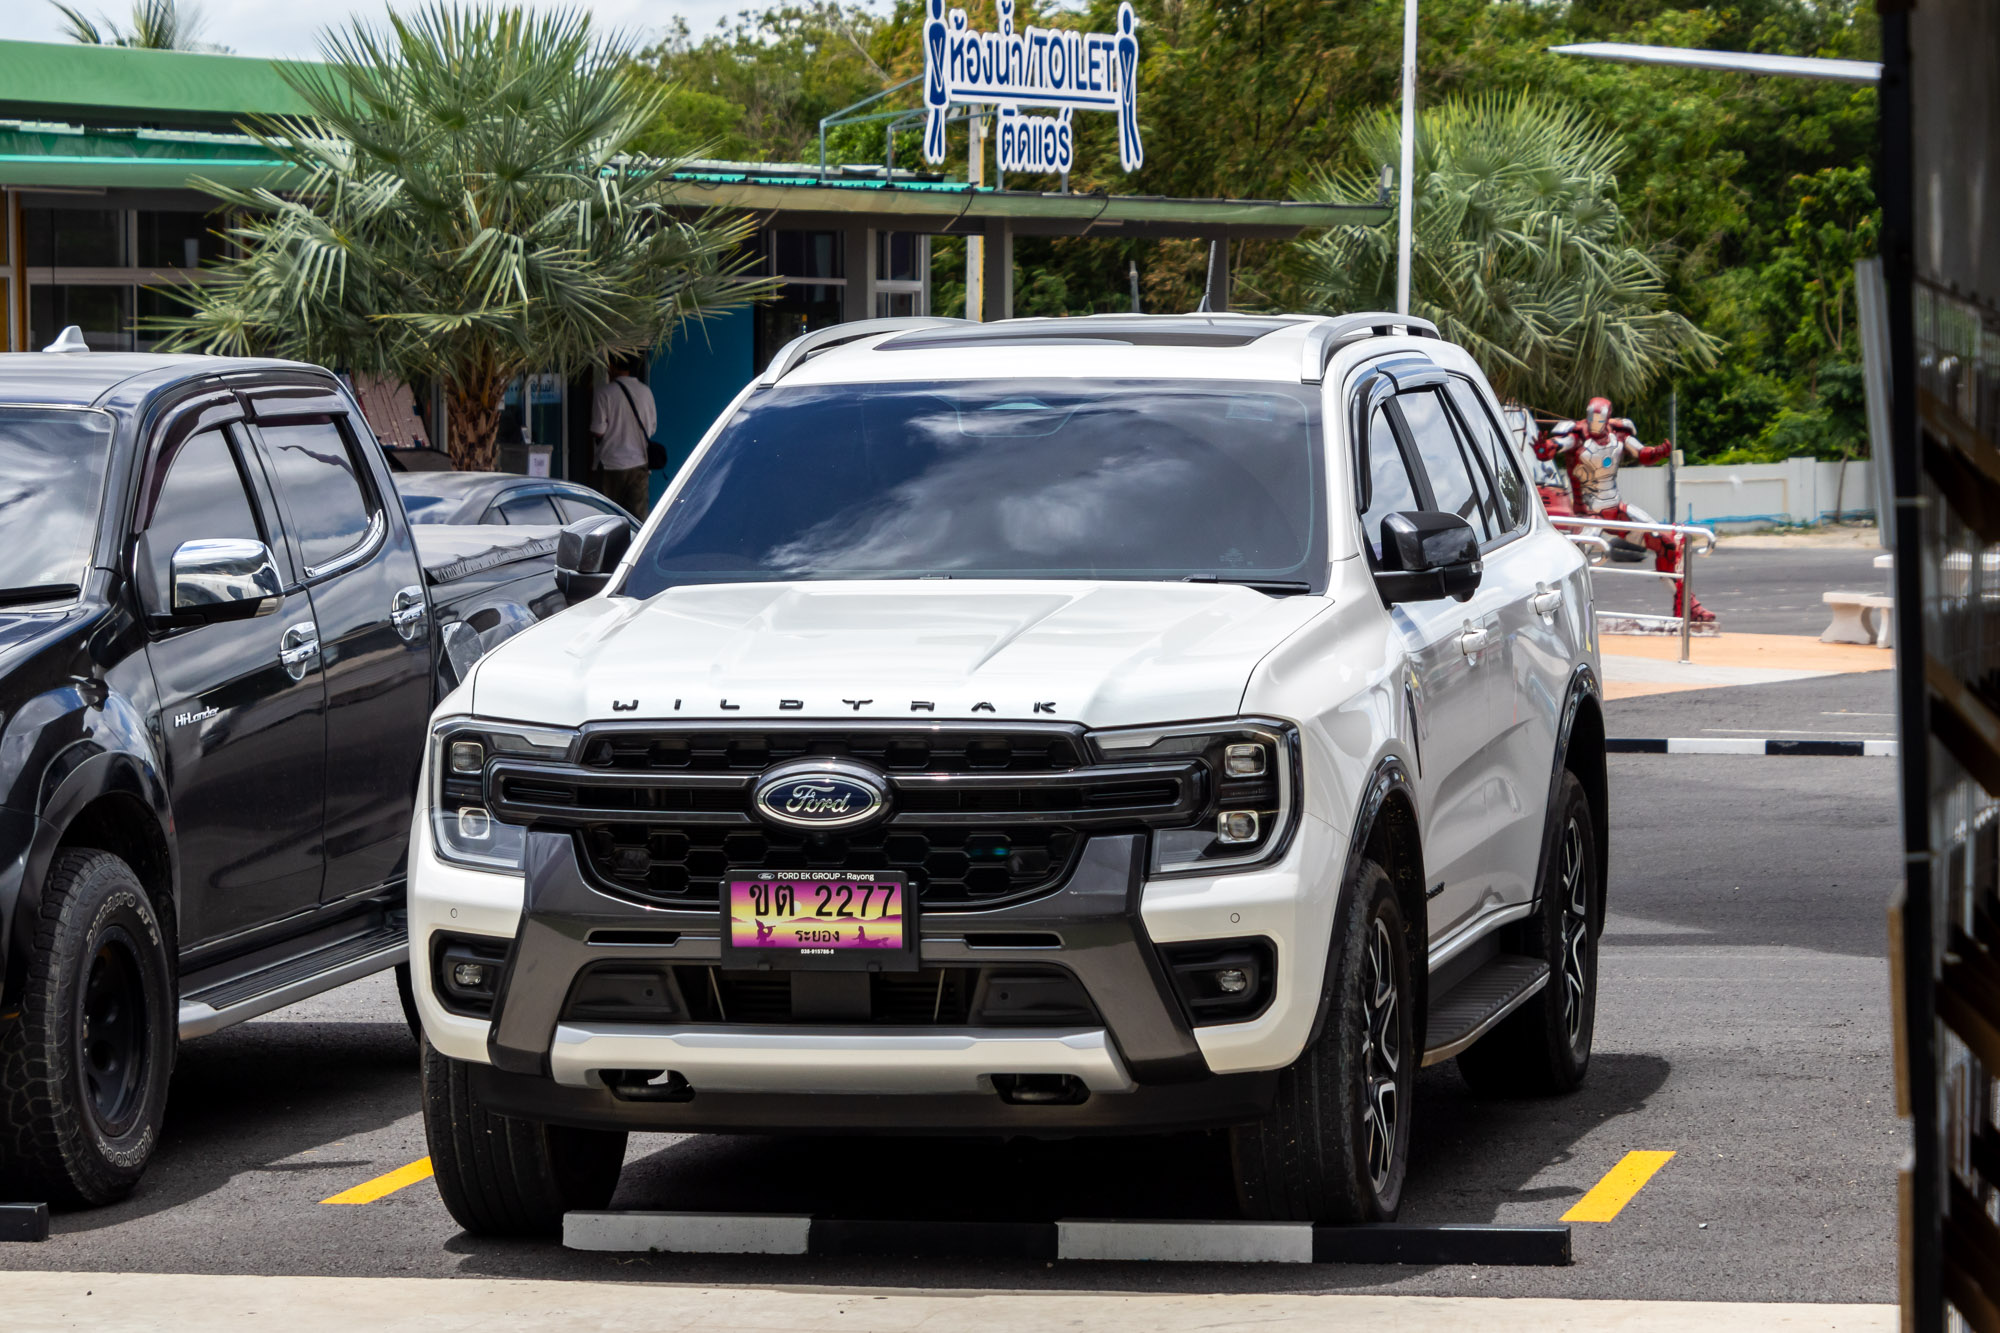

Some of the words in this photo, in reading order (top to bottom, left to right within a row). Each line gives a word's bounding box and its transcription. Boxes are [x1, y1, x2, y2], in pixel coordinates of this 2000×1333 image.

[1002, 108, 1069, 166] ติดแอร์
[613, 699, 1057, 713] WILDTRAK
[786, 785, 851, 814] Ford
[777, 872, 799, 880] FORD
[800, 872, 811, 880] EK
[812, 872, 840, 880] GROUP
[846, 872, 875, 881] Rayong
[749, 884, 794, 916] ขต
[814, 885, 896, 917] 2277
[795, 930, 840, 943] ระยอง
